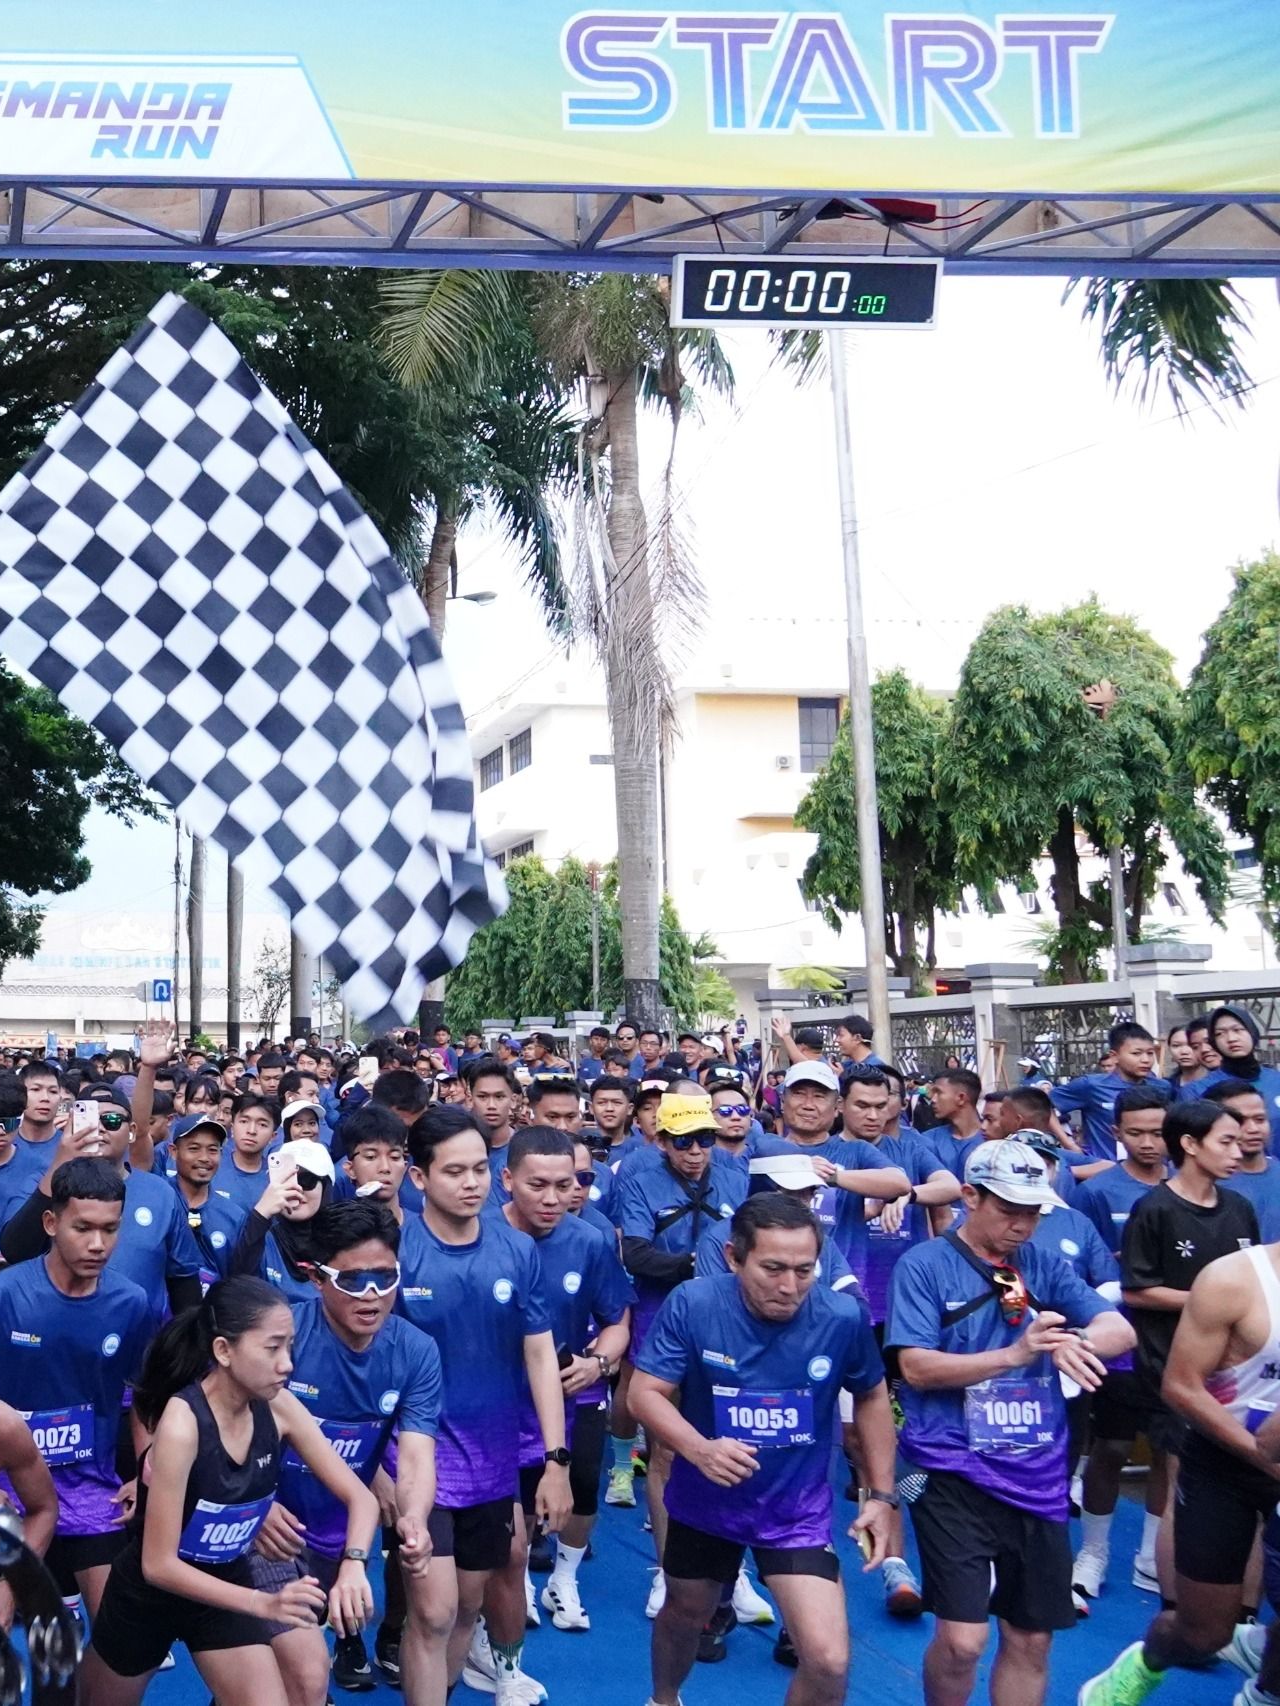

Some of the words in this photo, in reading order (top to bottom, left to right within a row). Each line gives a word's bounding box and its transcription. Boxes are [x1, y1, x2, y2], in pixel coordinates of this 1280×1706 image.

[560, 10, 1116, 140] START
[89, 124, 220, 160] RUN
[704, 269, 852, 314] 00:00
[727, 1406, 799, 1430] 10053
[983, 1400, 1042, 1426] 10061
[32, 1423, 81, 1449] 0073
[789, 1432, 812, 1443] 10K
[74, 1448, 93, 1459] 10K
[200, 1515, 261, 1545] 10027
